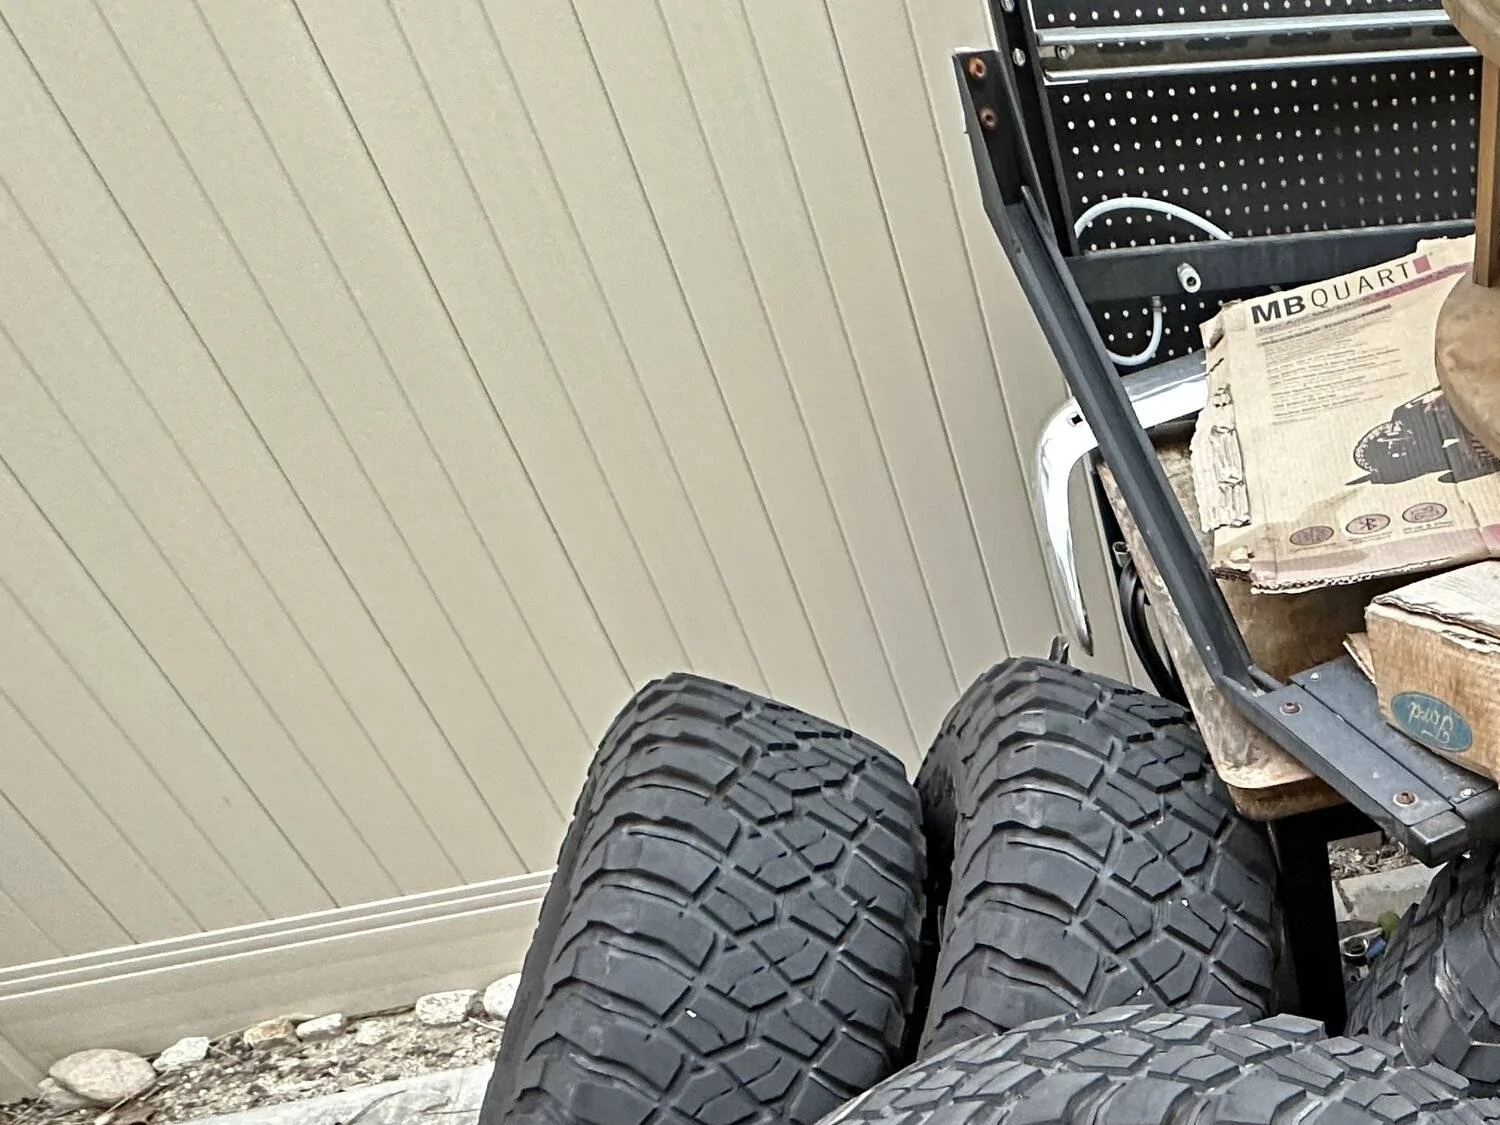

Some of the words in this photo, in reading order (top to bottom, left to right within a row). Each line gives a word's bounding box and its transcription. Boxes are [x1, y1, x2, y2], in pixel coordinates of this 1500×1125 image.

[1251, 295, 1306, 325] MB
[1311, 261, 1409, 308] QUART
[1408, 701, 1454, 744] Ford
